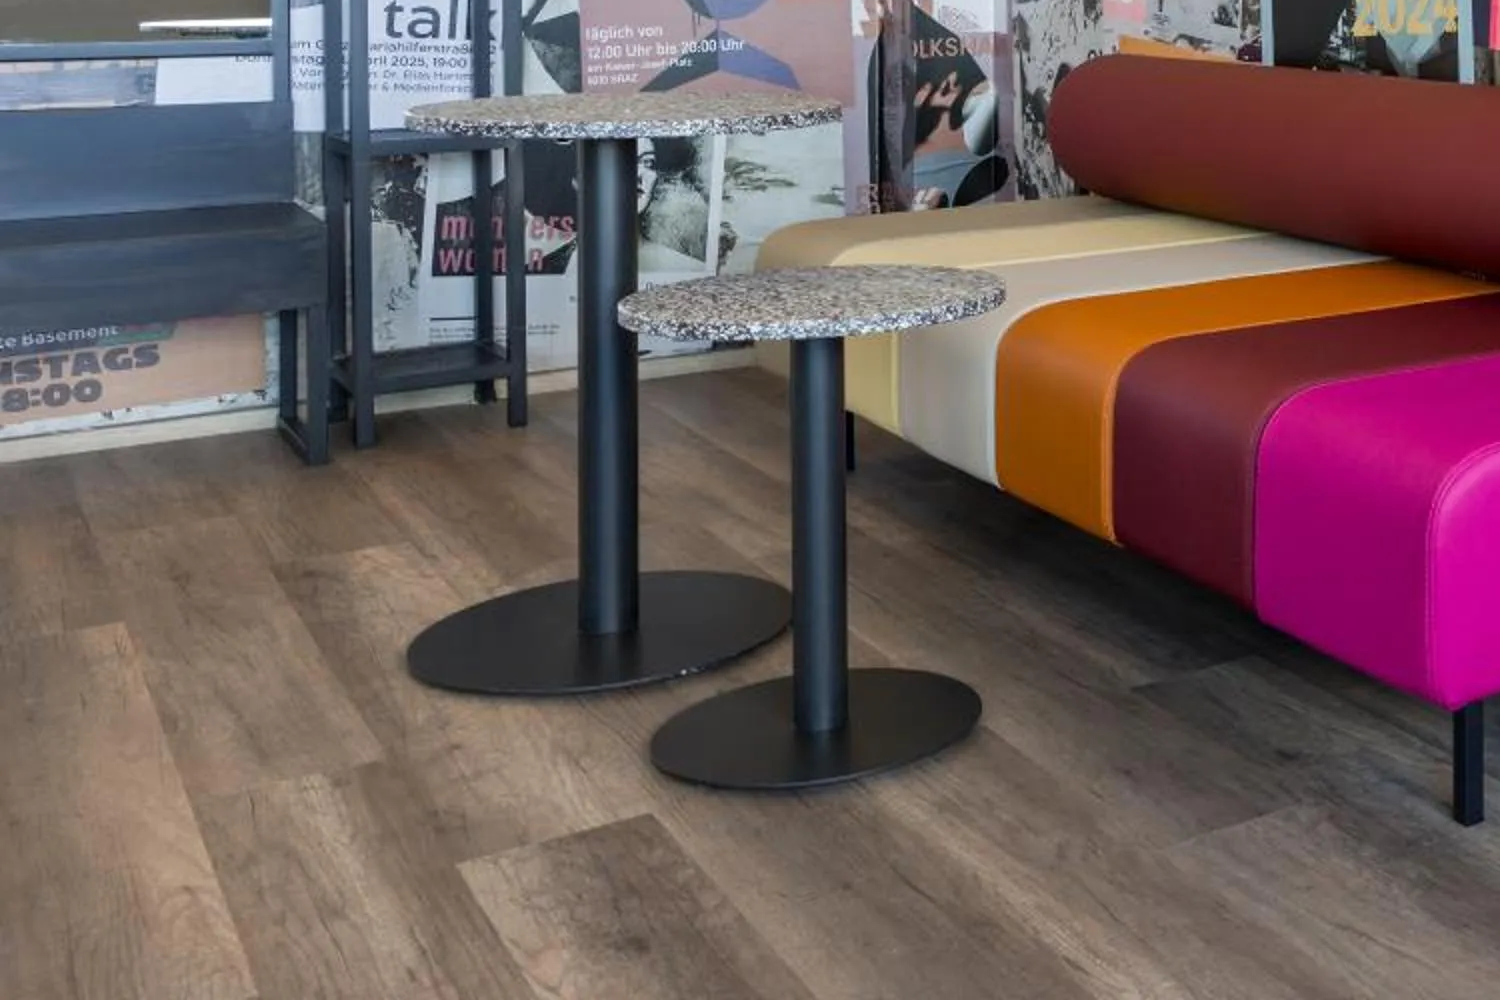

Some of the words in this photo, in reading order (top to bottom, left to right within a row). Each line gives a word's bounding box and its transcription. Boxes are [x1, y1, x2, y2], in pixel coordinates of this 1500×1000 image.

[637, 25, 663, 37] von
[656, 42, 679, 56] bis
[720, 38, 744, 51] Uhr
[21, 325, 120, 346] Basement
